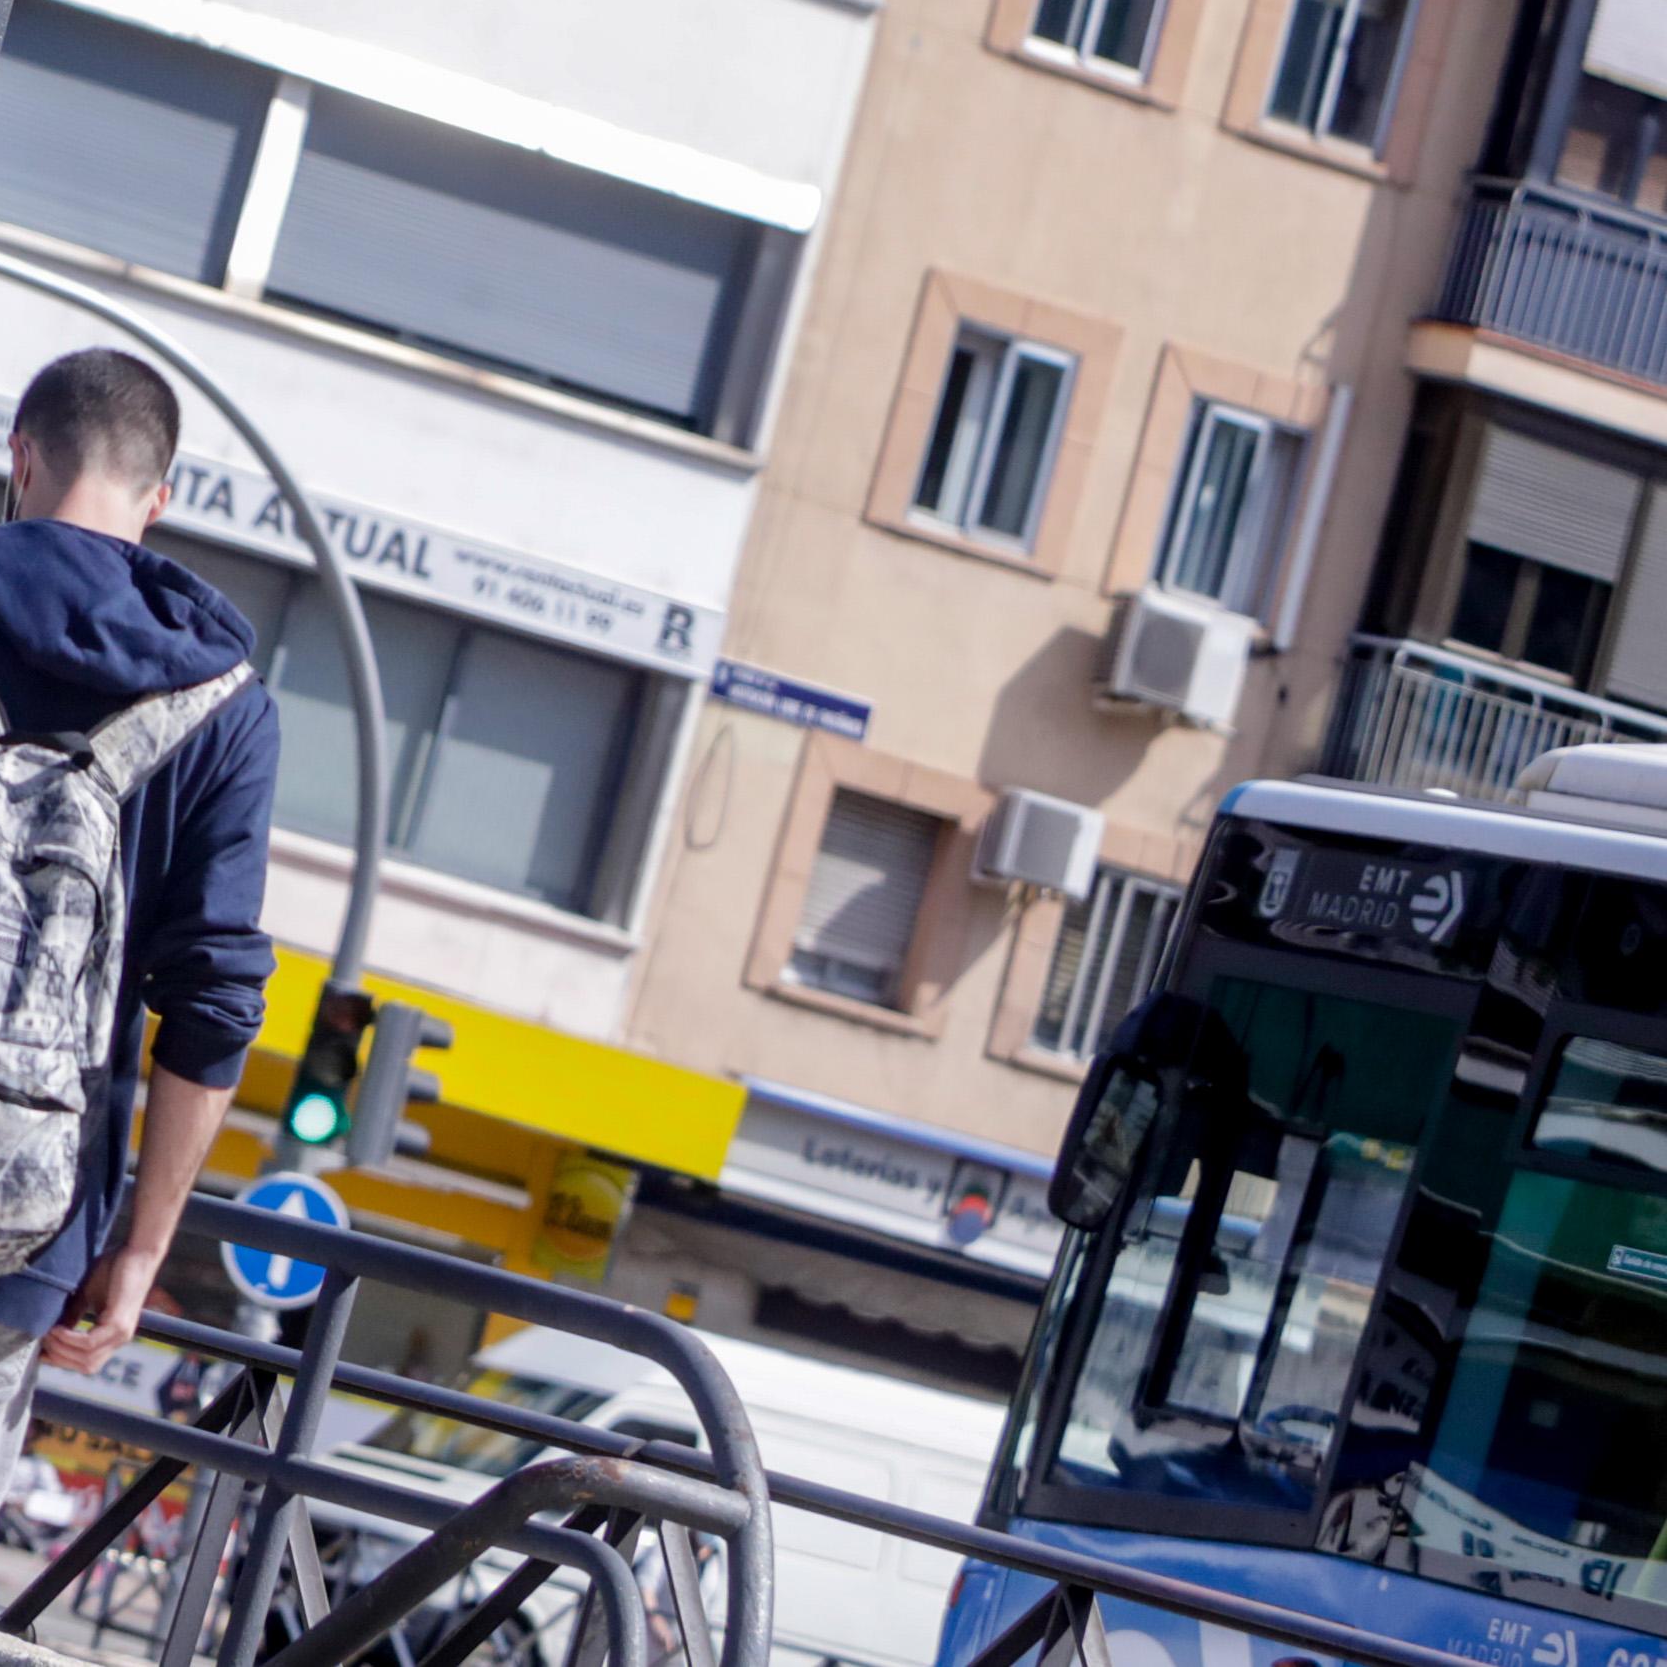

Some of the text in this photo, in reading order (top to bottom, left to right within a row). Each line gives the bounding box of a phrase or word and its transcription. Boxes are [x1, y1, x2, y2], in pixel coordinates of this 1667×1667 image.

[252, 492, 432, 580] ATUAL
[660, 602, 695, 651] R
[1358, 864, 1413, 897] EMT
[1307, 890, 1401, 929] MADRID
[1486, 1616, 1533, 1649] EMT
